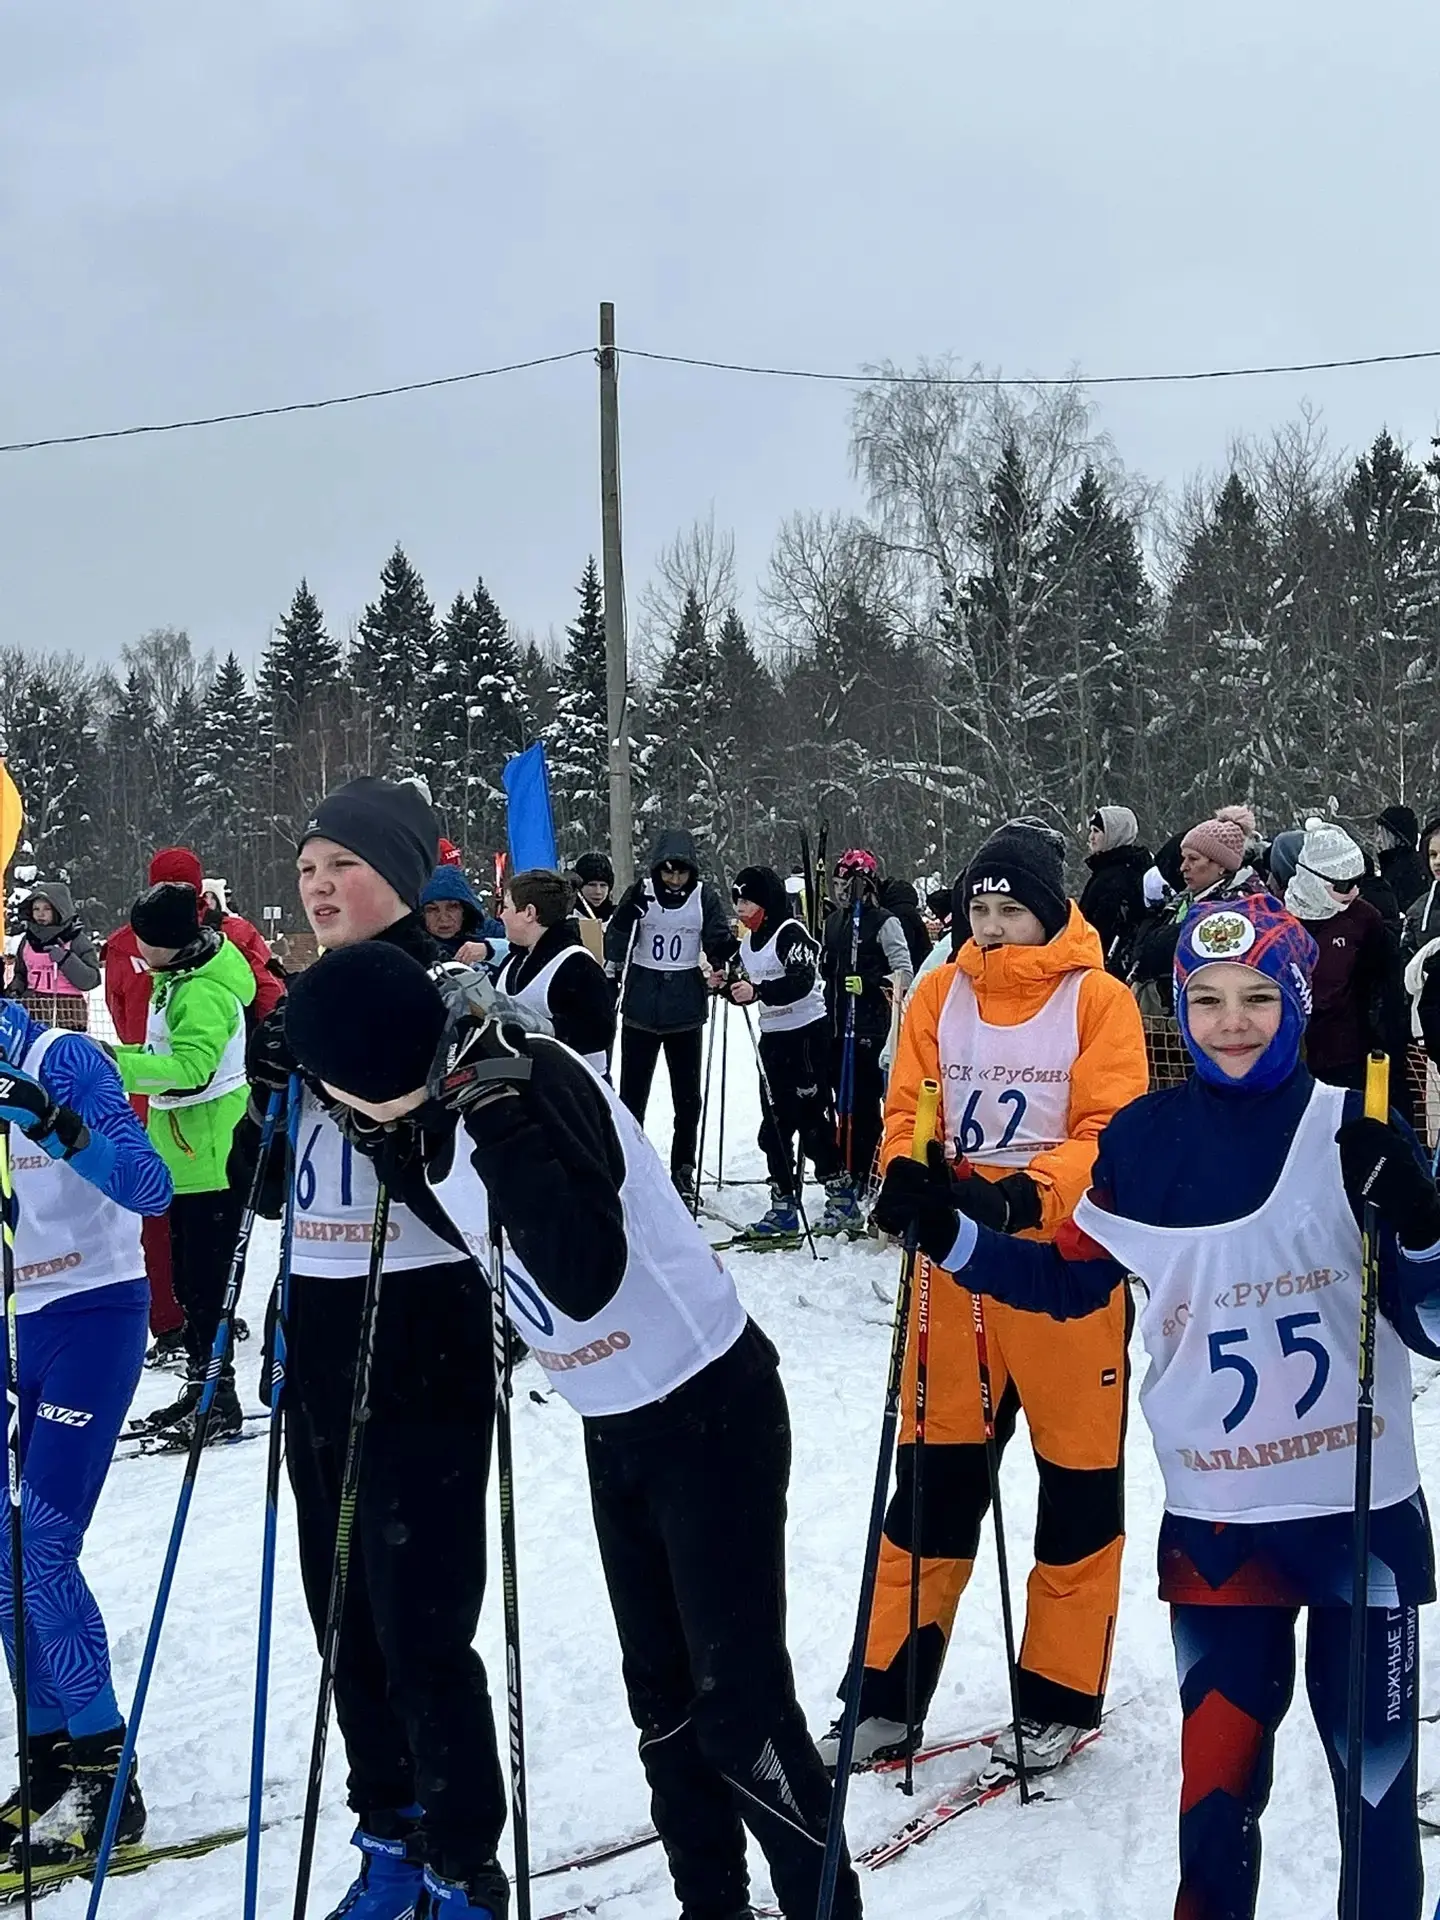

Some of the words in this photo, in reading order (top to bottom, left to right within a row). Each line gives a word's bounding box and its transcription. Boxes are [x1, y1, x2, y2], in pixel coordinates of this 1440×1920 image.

[972, 877, 1010, 895] FILA
[652, 934, 682, 962] 80
[31, 970, 51, 990] 71
[978, 1065, 1072, 1085] «Рубин»
[960, 1089, 1027, 1154] 62
[297, 1123, 353, 1210] 61
[222, 1206, 254, 1311] SPINE
[919, 1254, 931, 1334] MADSHUS
[1214, 1268, 1350, 1308] «Рубин»
[1207, 1311, 1331, 1434] 55
[37, 1402, 94, 1427] KV+
[1387, 1626, 1402, 1721] ЛЫЖНЫЕ
